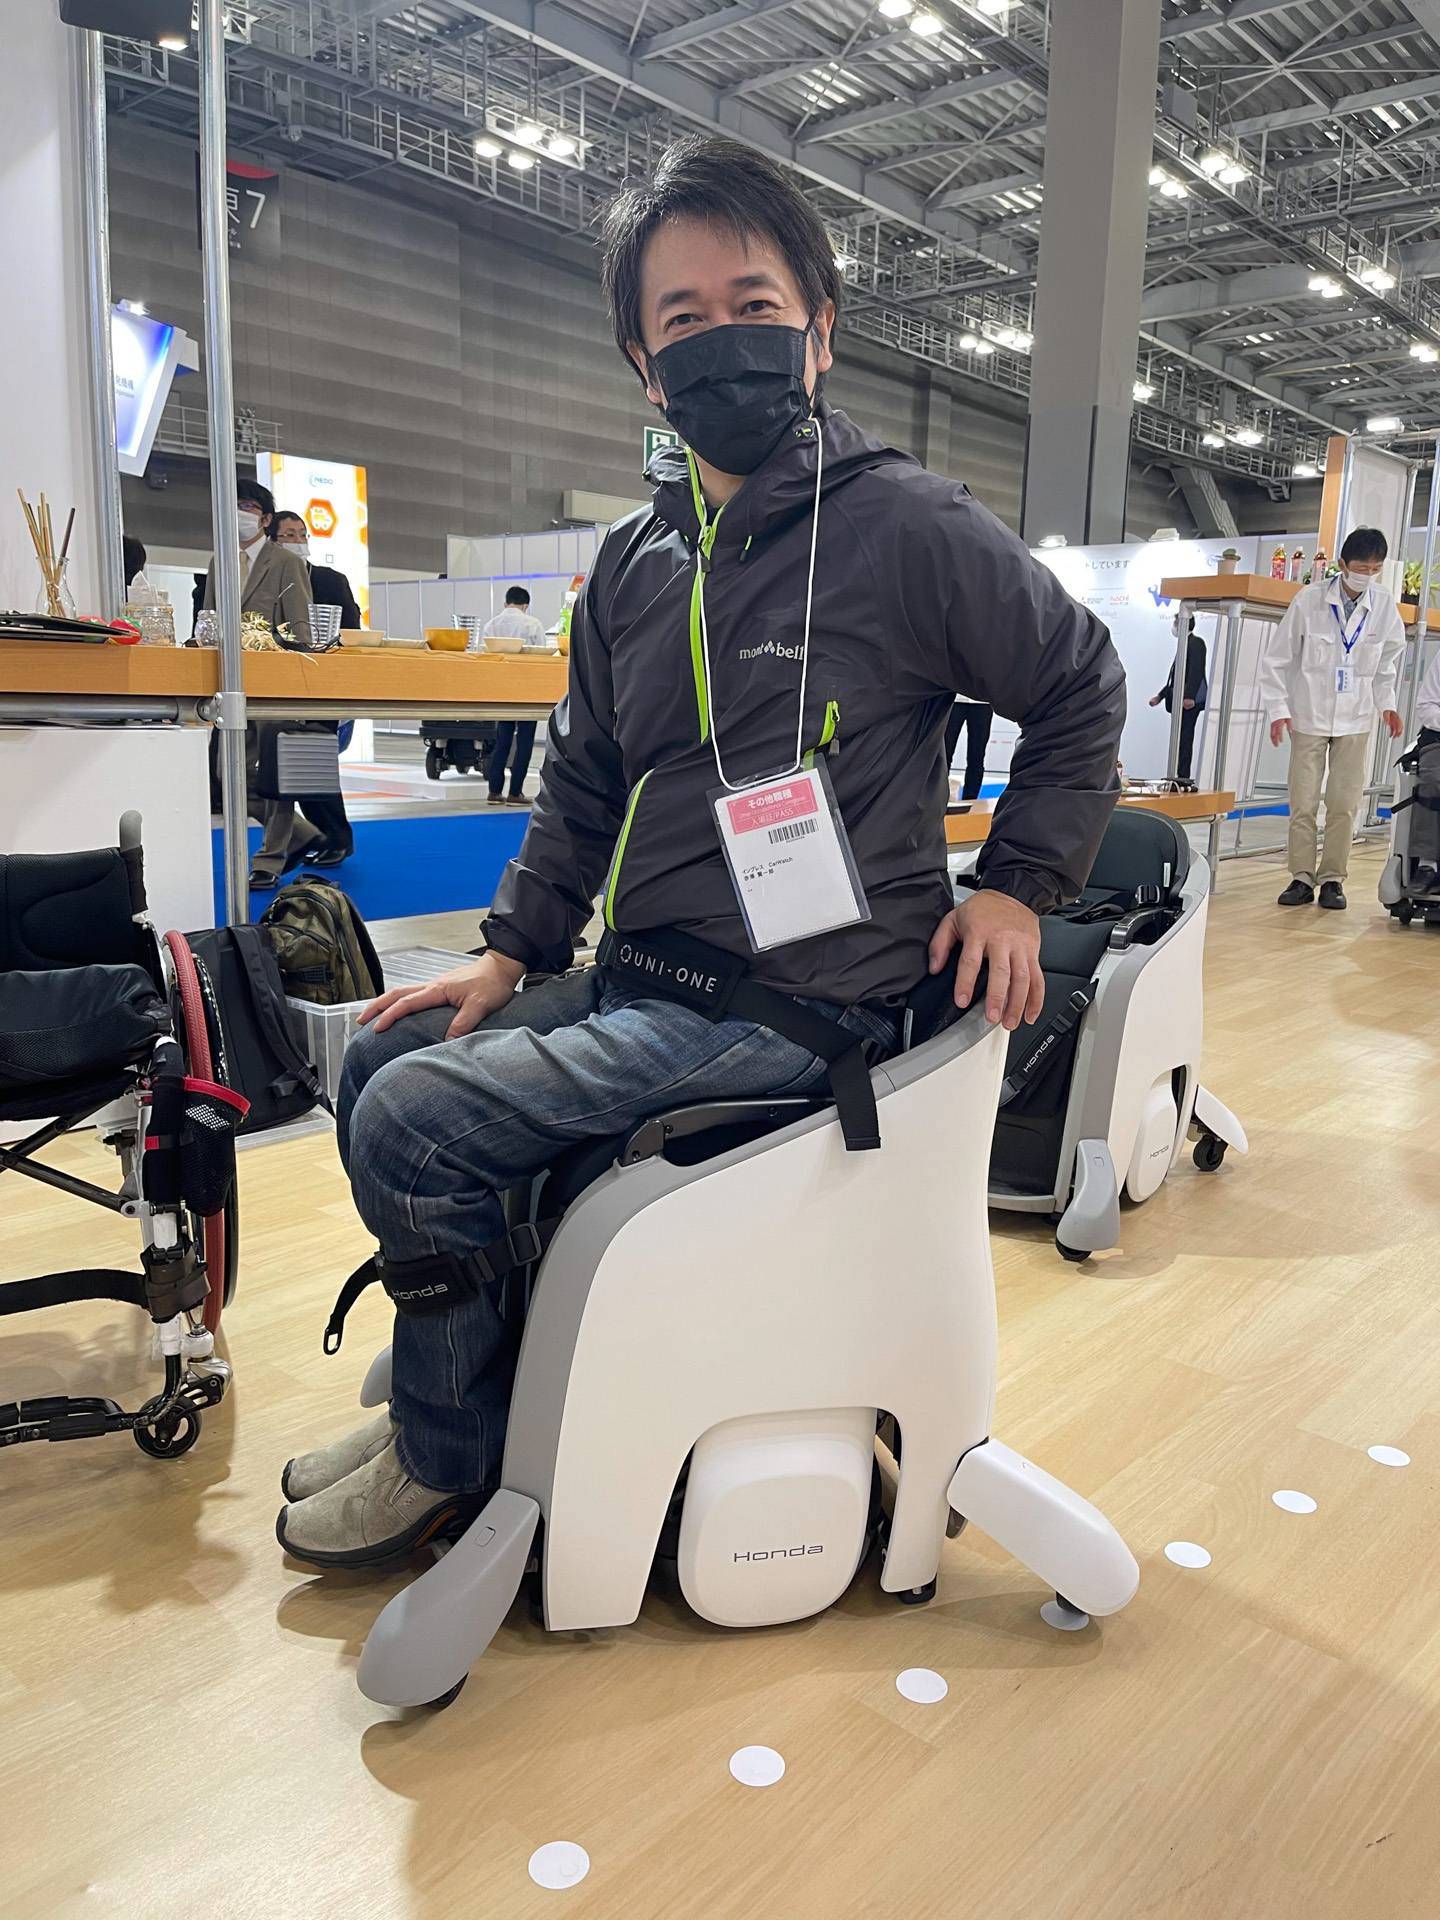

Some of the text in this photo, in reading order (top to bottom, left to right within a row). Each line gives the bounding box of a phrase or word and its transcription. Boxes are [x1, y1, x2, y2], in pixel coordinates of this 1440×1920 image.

[747, 788, 793, 809] その他職種
[634, 951, 717, 993] UNI-ONE
[1022, 1034, 1055, 1073] Honda
[1149, 1144, 1170, 1160] Honda
[391, 1283, 448, 1300] Honda
[733, 1544, 823, 1563] Honda
